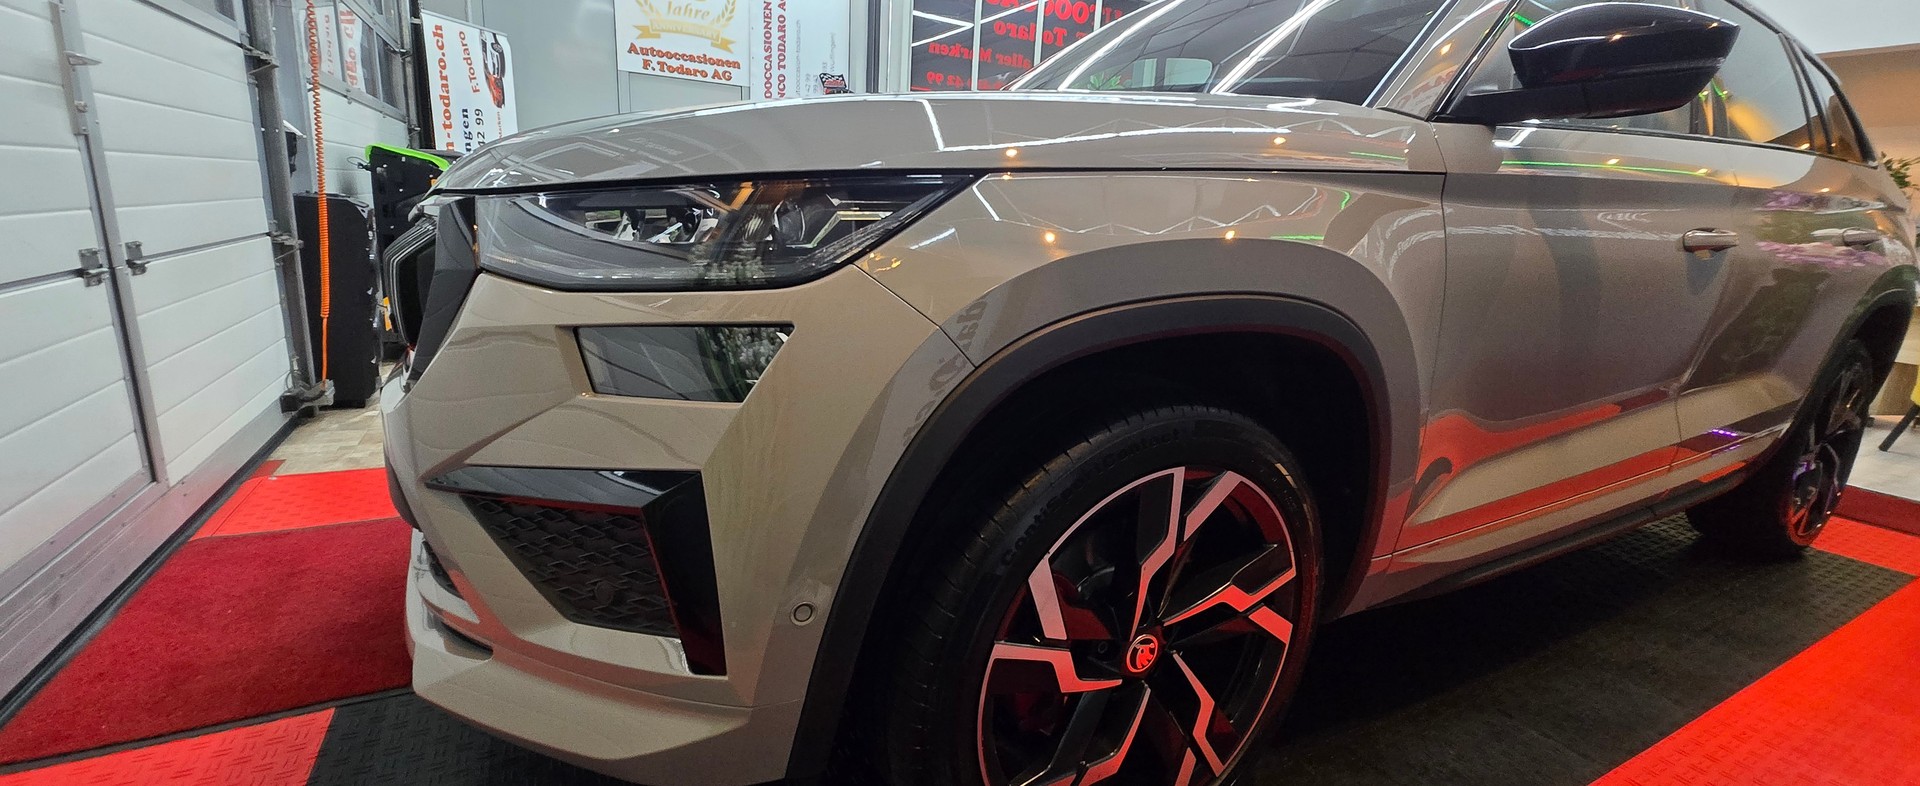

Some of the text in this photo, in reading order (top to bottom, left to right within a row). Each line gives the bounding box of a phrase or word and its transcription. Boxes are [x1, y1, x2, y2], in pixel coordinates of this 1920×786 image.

[666, 1, 710, 20] Jahre
[777, 14, 786, 71] TODARO
[627, 42, 741, 70] Autooccasionen
[711, 69, 733, 81] AG
[474, 108, 485, 126] 99
